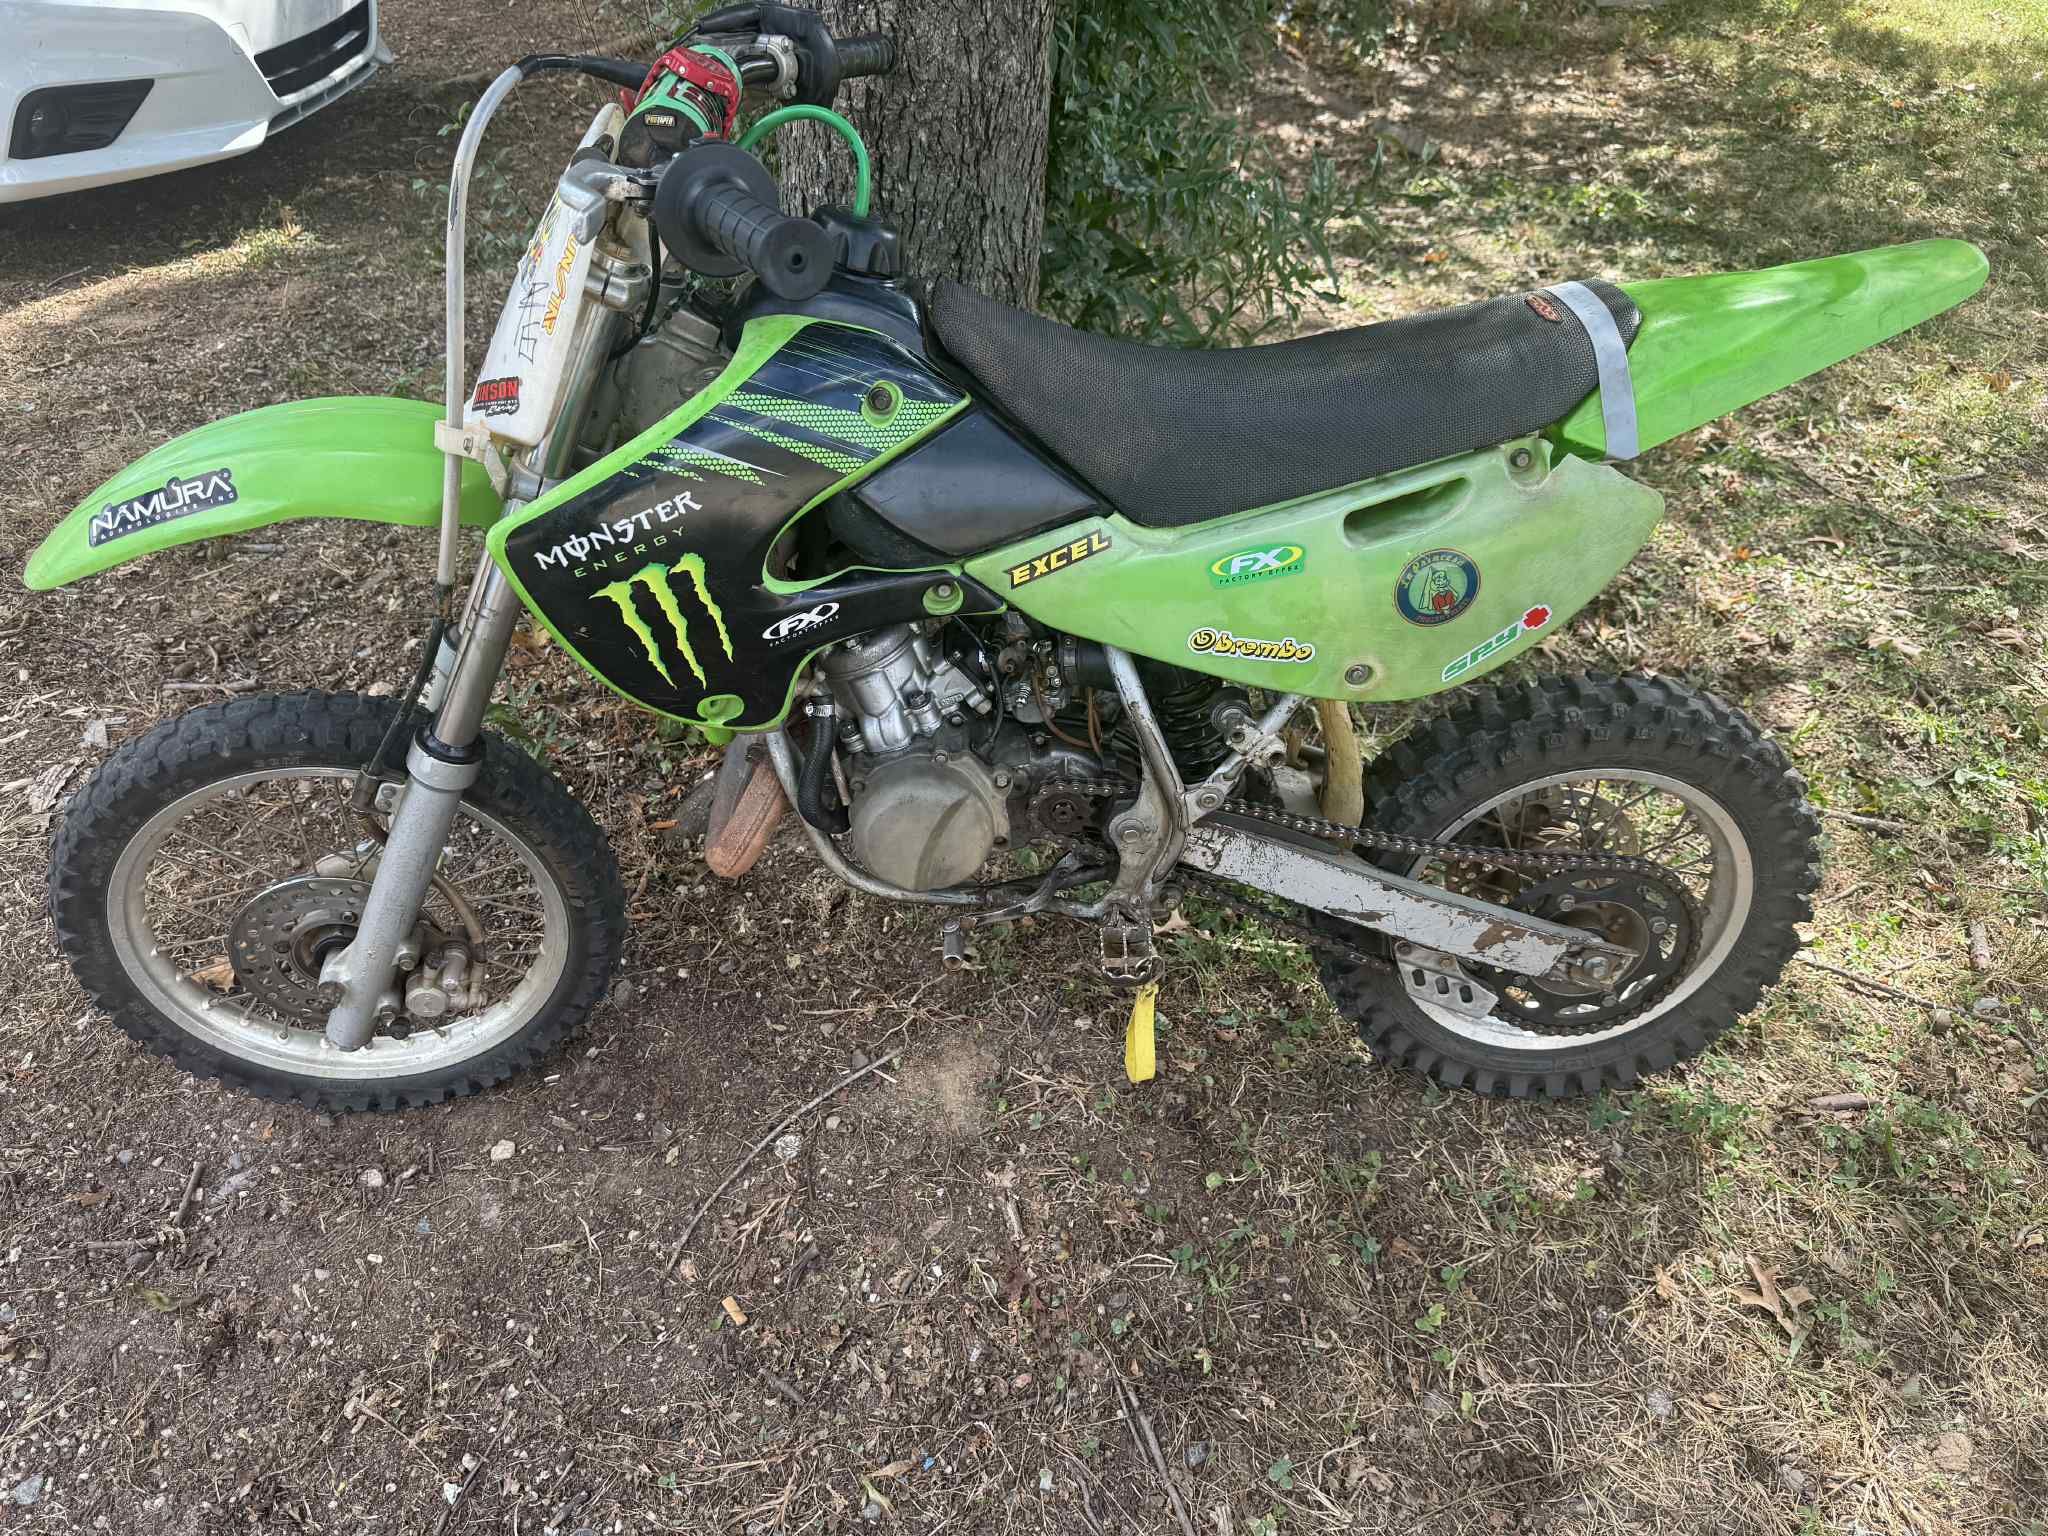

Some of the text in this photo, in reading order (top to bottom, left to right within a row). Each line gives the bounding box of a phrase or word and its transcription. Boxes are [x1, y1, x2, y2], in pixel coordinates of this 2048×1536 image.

[91, 475, 232, 537] NAMURA
[534, 491, 703, 571] MONSTER
[574, 526, 684, 578] ENERGY
[1012, 533, 1109, 585] EXCEL
[1219, 571, 1263, 585] FACTORY
[1230, 546, 1286, 576] FX
[1215, 633, 1312, 660] brembo
